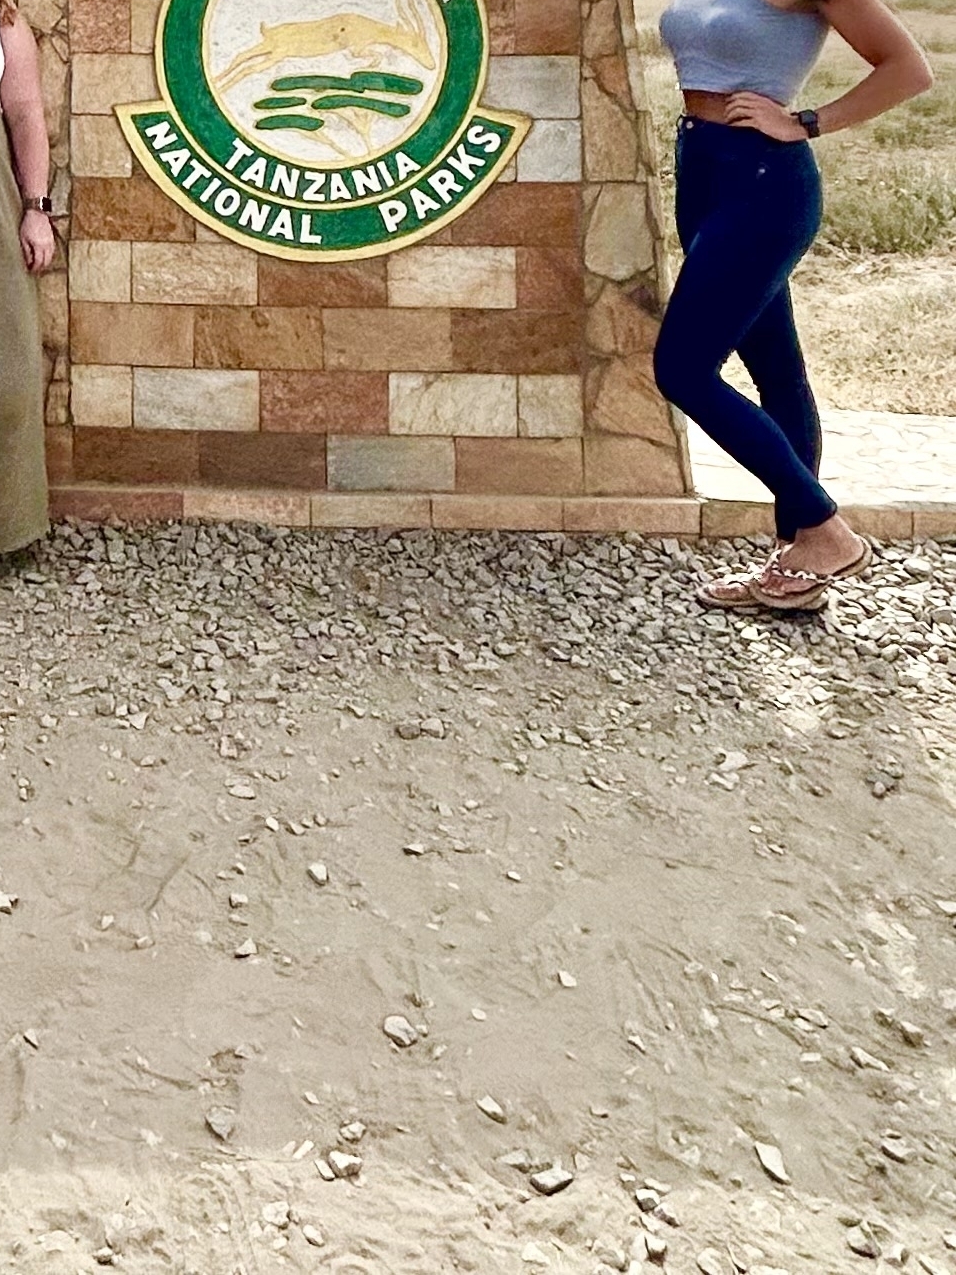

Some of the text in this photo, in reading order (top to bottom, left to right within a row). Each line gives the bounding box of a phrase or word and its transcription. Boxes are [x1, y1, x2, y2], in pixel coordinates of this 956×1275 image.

[144, 120, 502, 245] NATIONAL PARKS
[223, 138, 422, 203] TANZANIA
